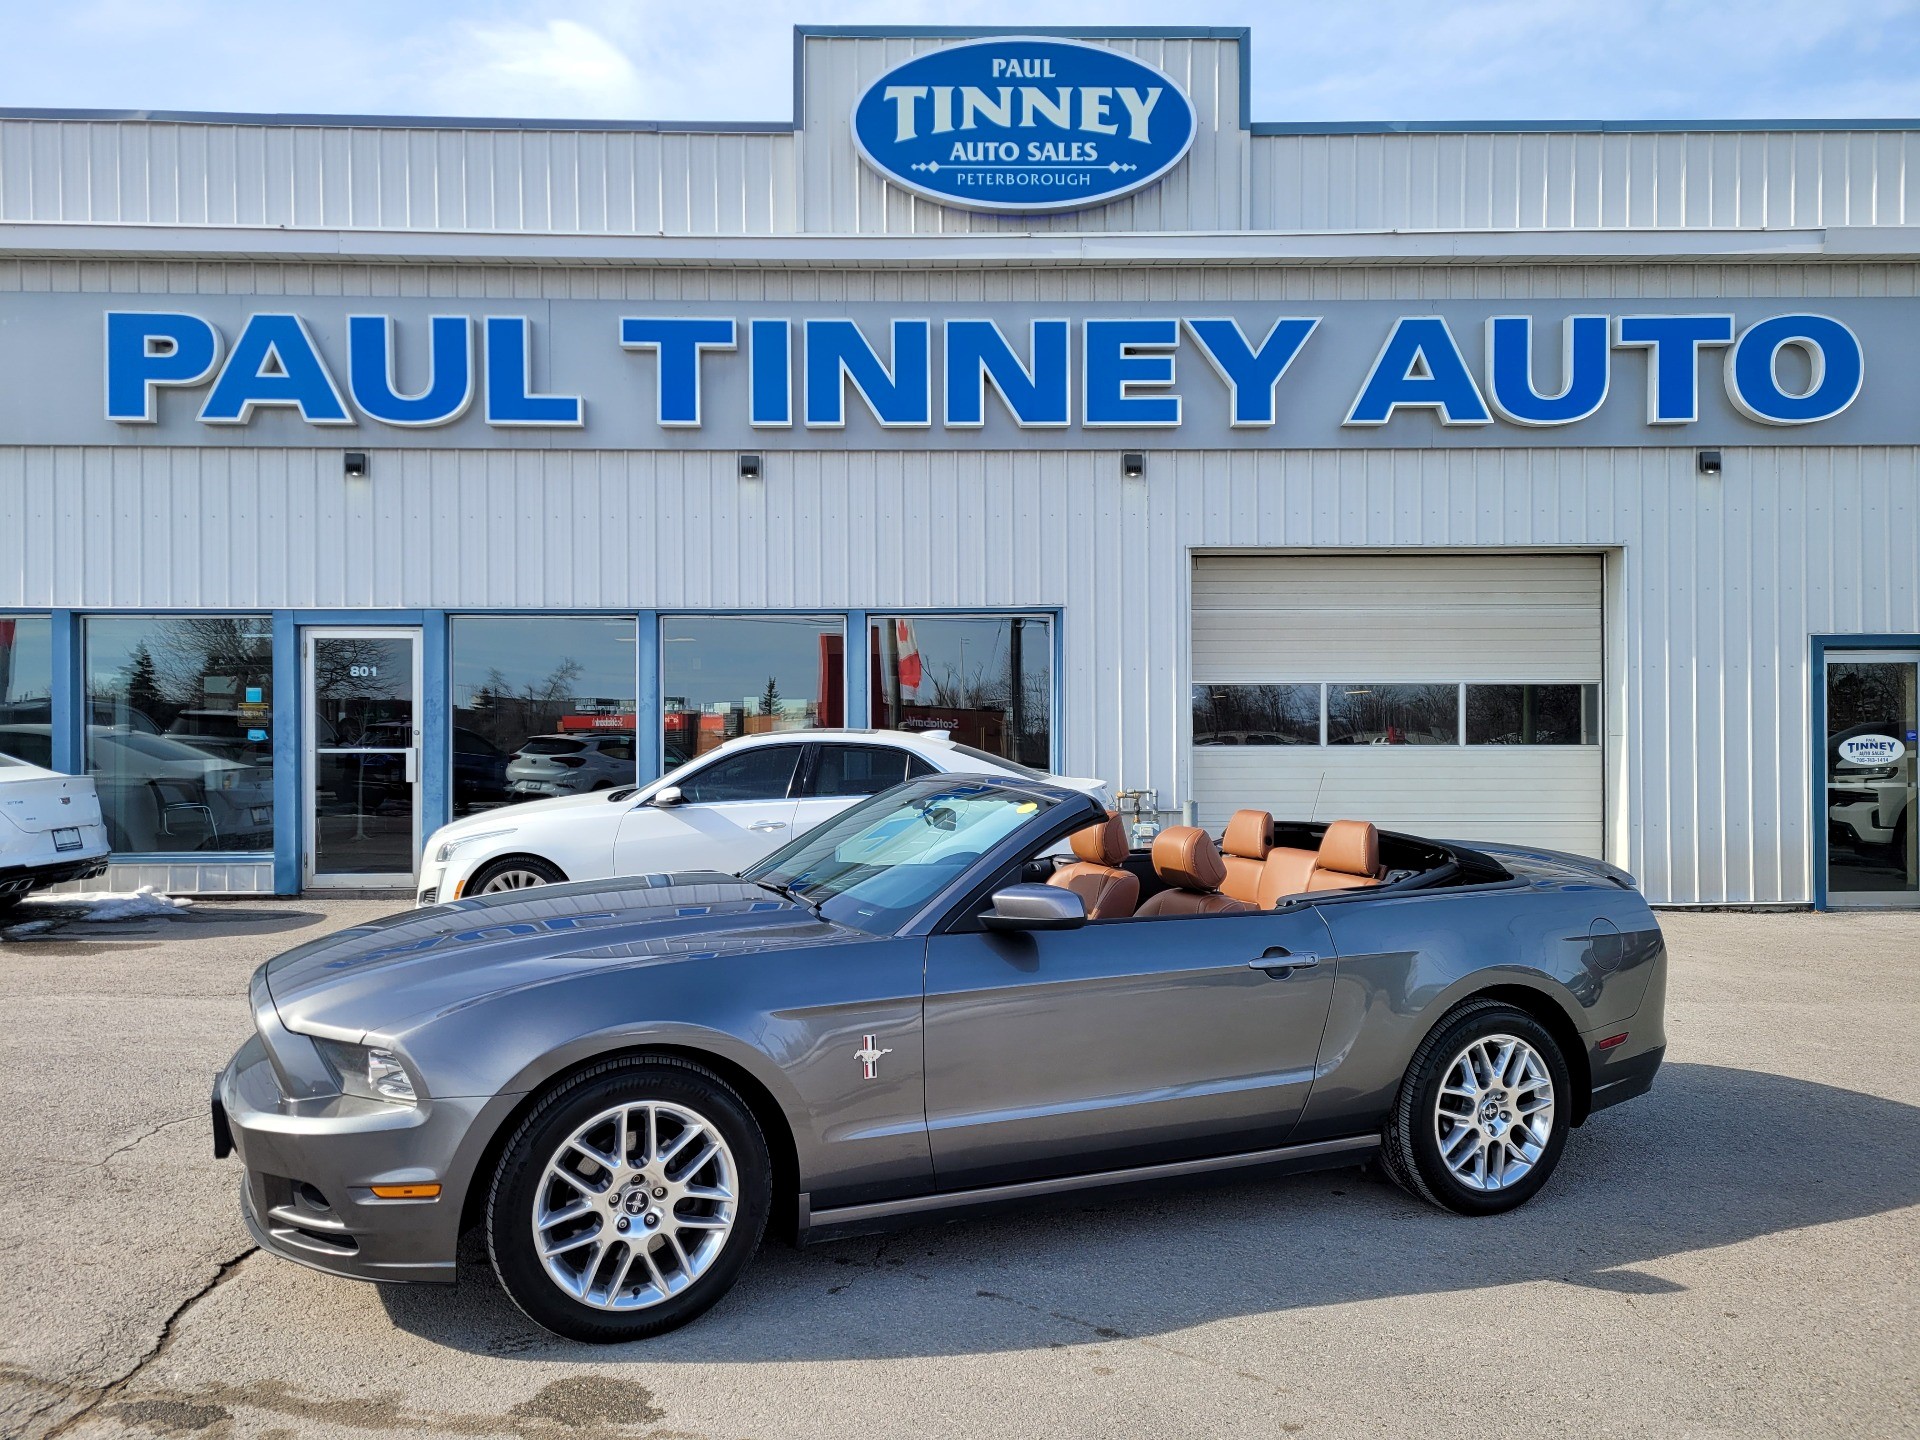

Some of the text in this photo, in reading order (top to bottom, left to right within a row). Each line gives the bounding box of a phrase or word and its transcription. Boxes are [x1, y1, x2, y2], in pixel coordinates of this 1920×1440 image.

[992, 58, 1057, 78] PAUL
[883, 85, 1163, 145] TINNEY
[949, 141, 1099, 162] AUTO SALES
[957, 172, 1091, 187] PETERBOROUGH
[103, 309, 1866, 430] PAUL TINNEY AUTO
[350, 666, 377, 677] 801
[1847, 742, 1895, 753] TINNEY
